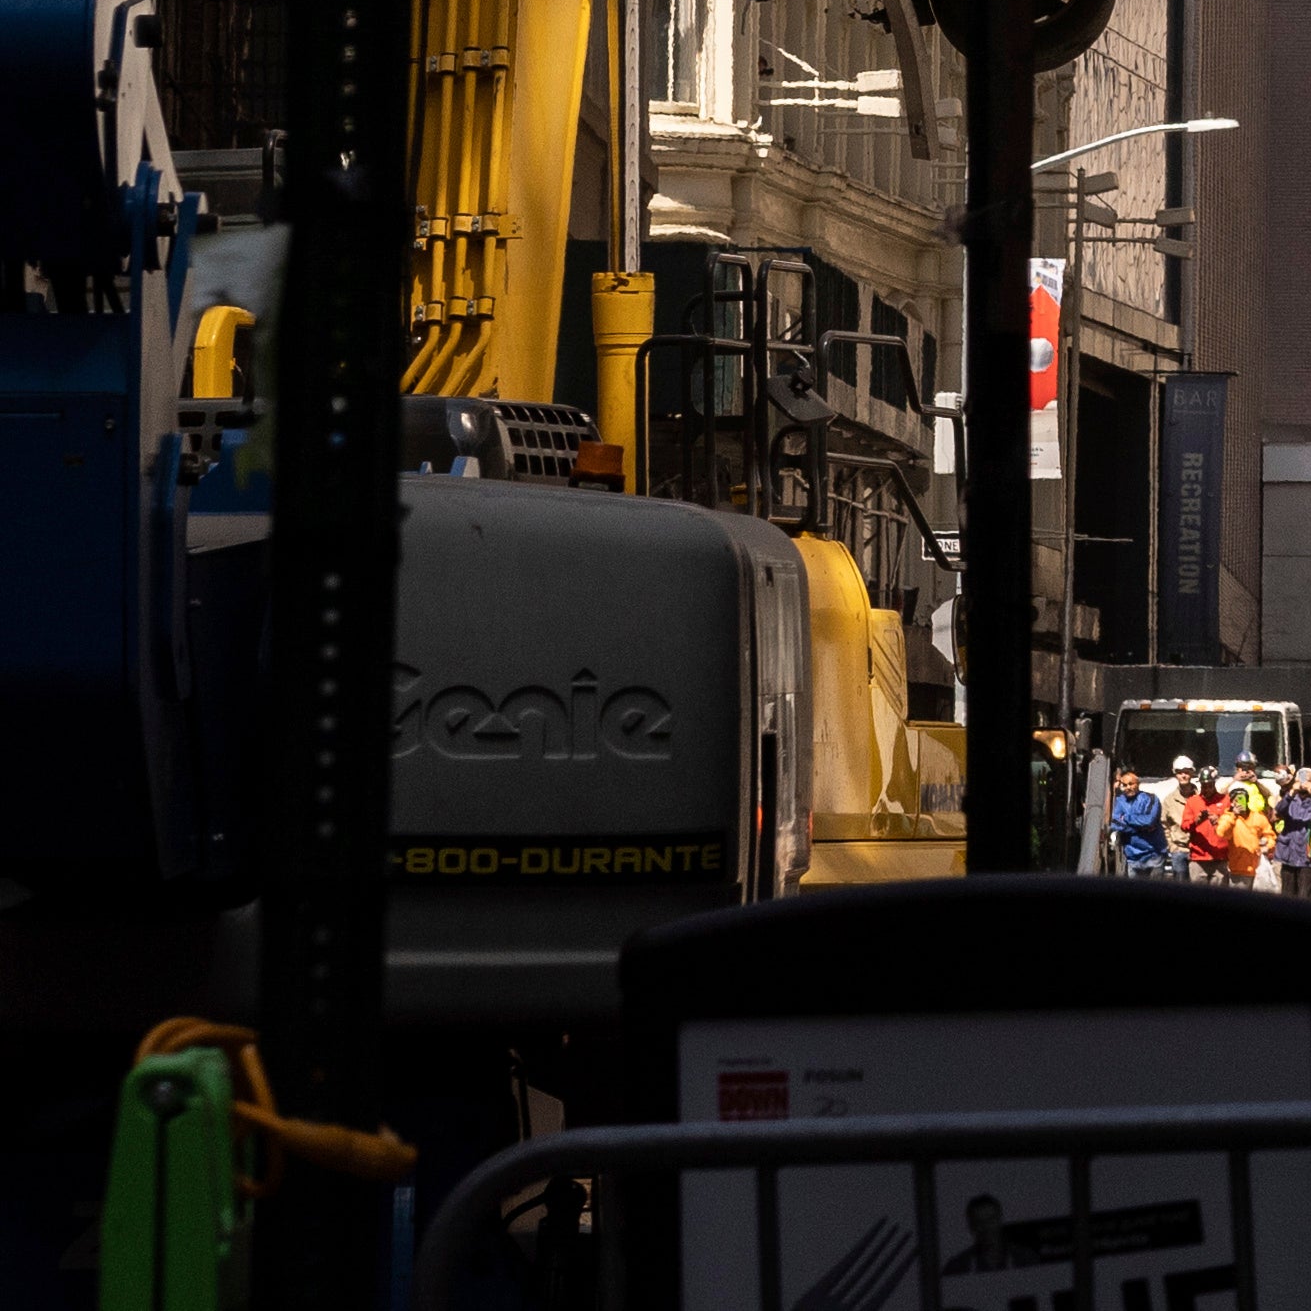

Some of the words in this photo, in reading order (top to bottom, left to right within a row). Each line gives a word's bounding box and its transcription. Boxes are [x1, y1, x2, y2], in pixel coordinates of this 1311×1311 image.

[1173, 390, 1217, 406] BAR
[1178, 453, 1204, 594] RECREATION
[388, 843, 722, 876] -800-DURANTE
